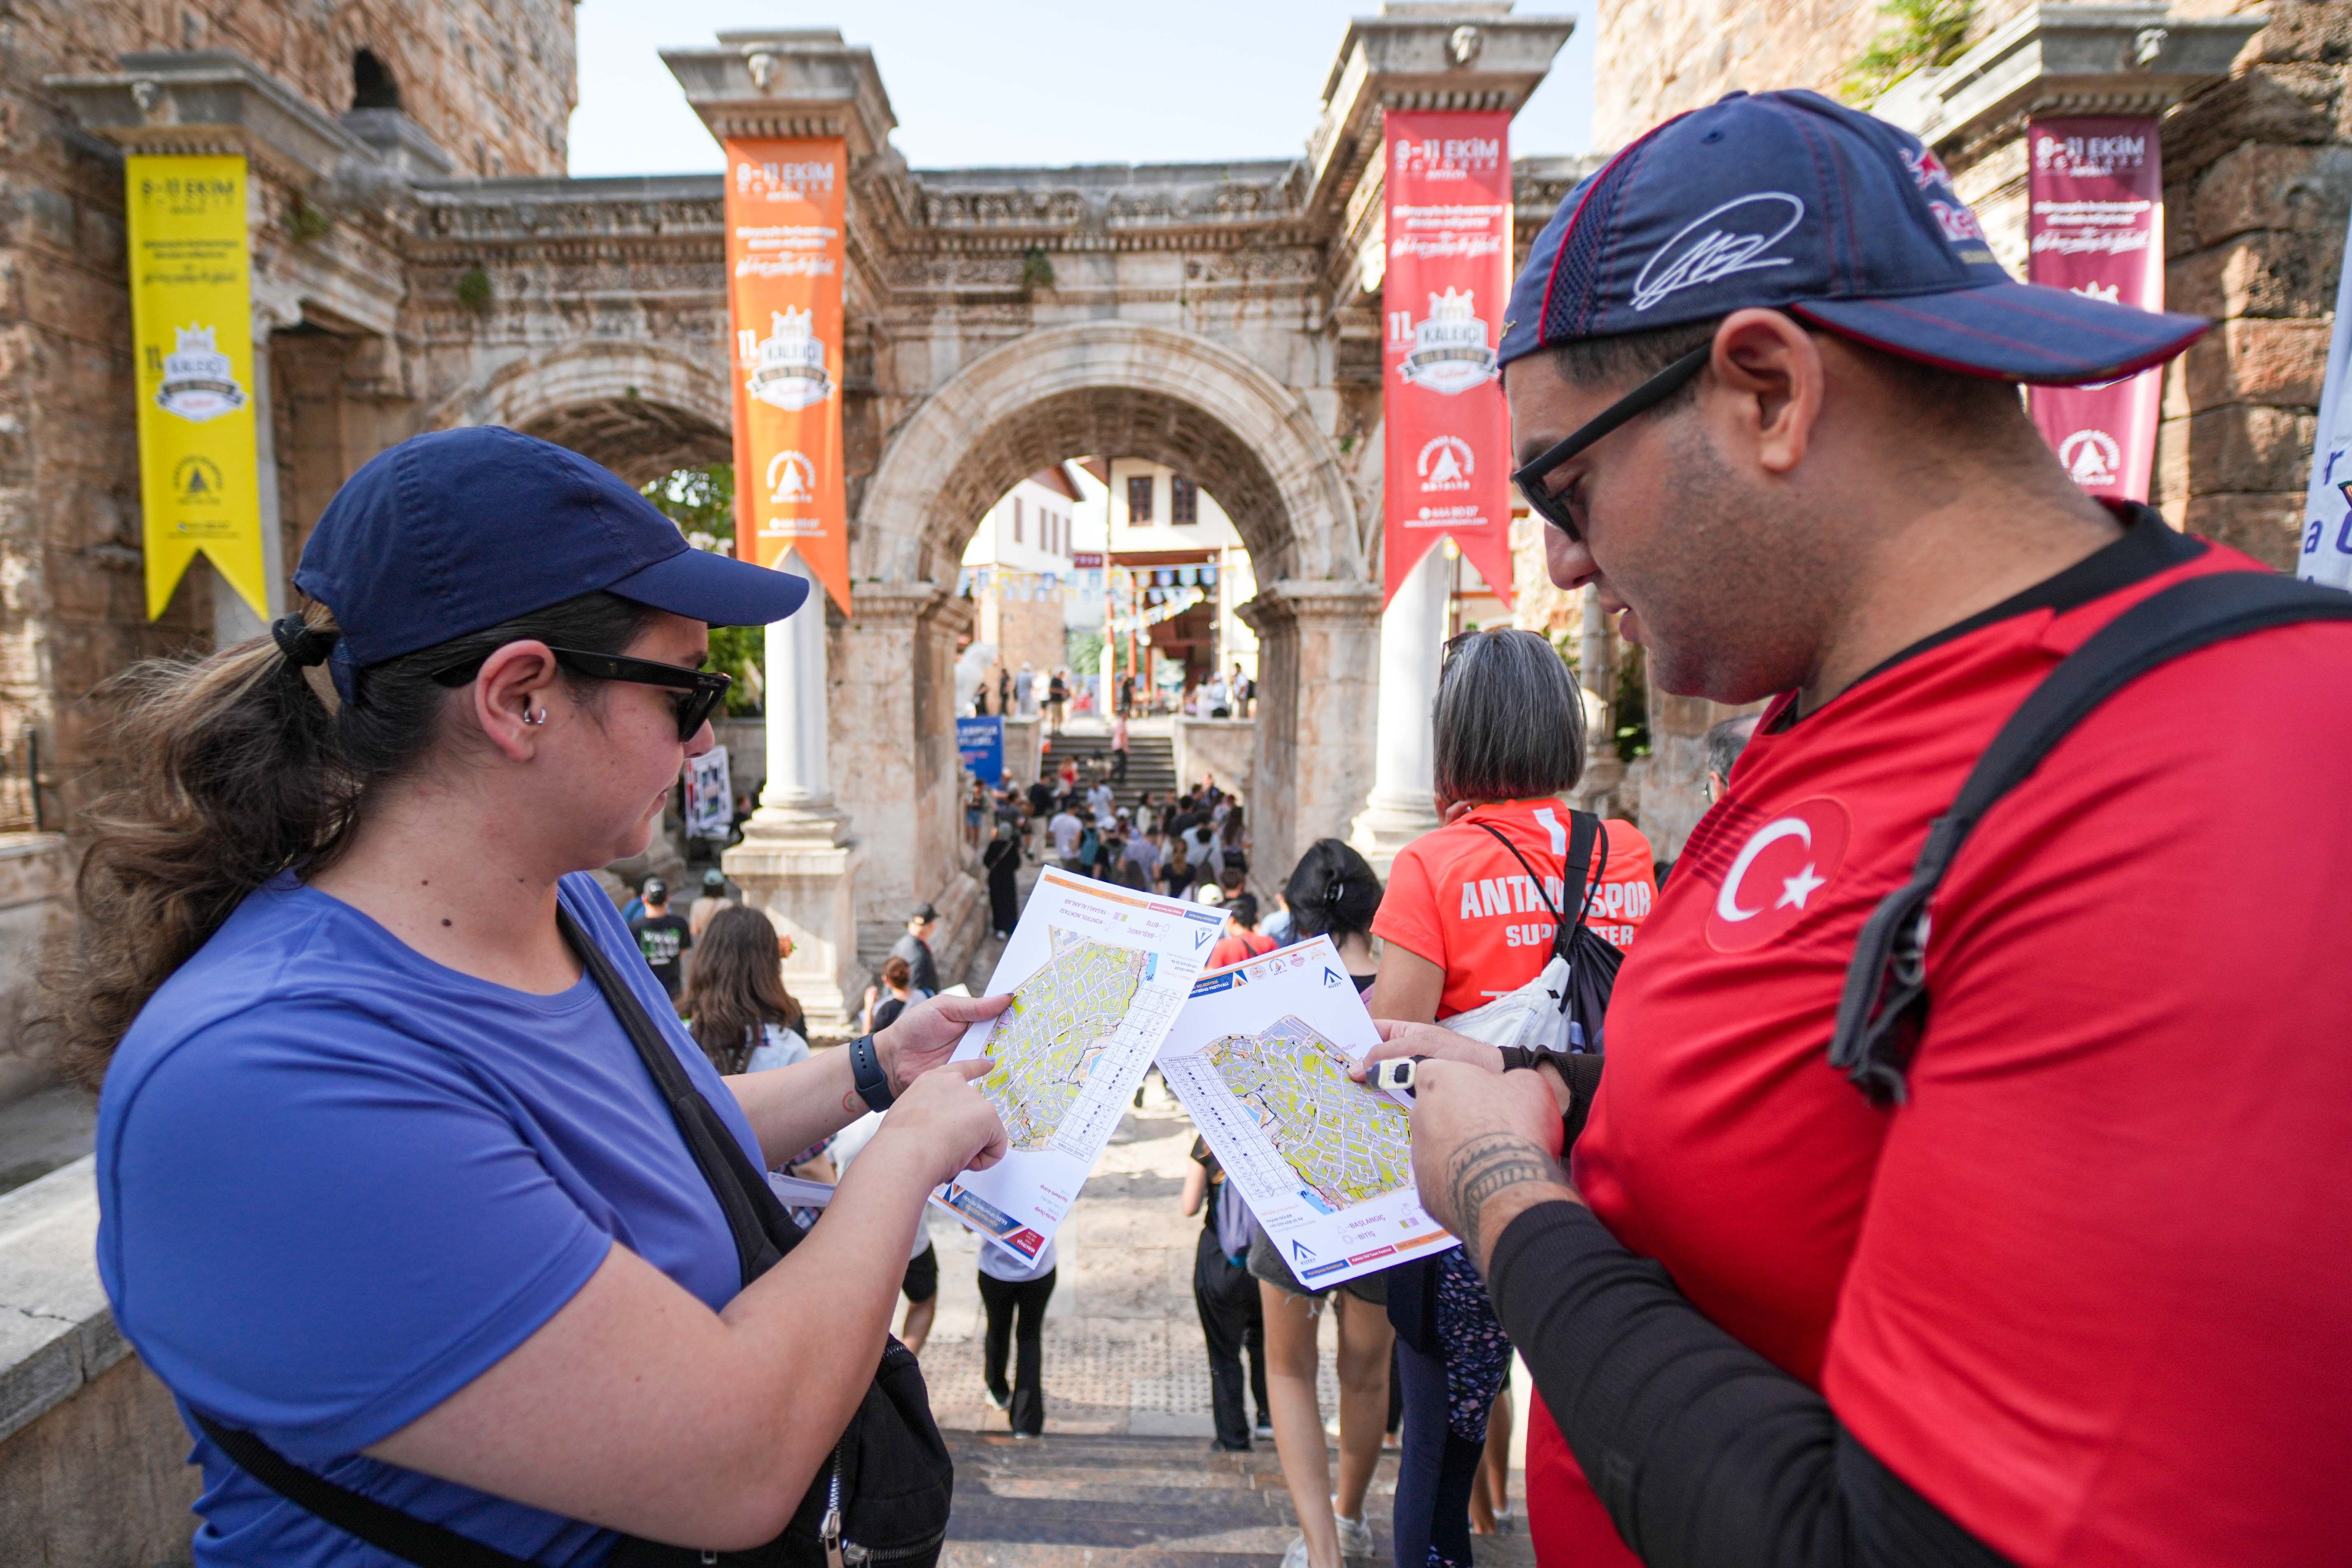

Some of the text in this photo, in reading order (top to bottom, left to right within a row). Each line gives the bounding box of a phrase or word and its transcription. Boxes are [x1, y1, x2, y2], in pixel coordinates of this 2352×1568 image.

[1395, 138, 1499, 161] 8-11 EKİM
[2036, 135, 2145, 158] 8-11 EKİM
[1396, 159, 1498, 171] OCTOBER
[2037, 156, 2143, 169] OCTOBER
[737, 161, 834, 181] 8-11 EKİM
[737, 181, 833, 192] OCTOBER
[1461, 875, 1651, 919] ANTALYSPOR
[1064, 899, 1107, 914] YASAKLI ALANLAR
[1059, 908, 1103, 924] KONTROL NOKTASI
[1127, 927, 1154, 938] BAŞLANGIÇ
[1196, 980, 1218, 988] BELEDİYESİ
[1209, 982, 1229, 990] FESTİVALİ
[1045, 1213, 1057, 1222] Harita
[1350, 1215, 1386, 1230] BAŞLANGIÇ
[1357, 1230, 1376, 1241] BİTİŞ
[1016, 1239, 1036, 1252] MURATPAŞA
